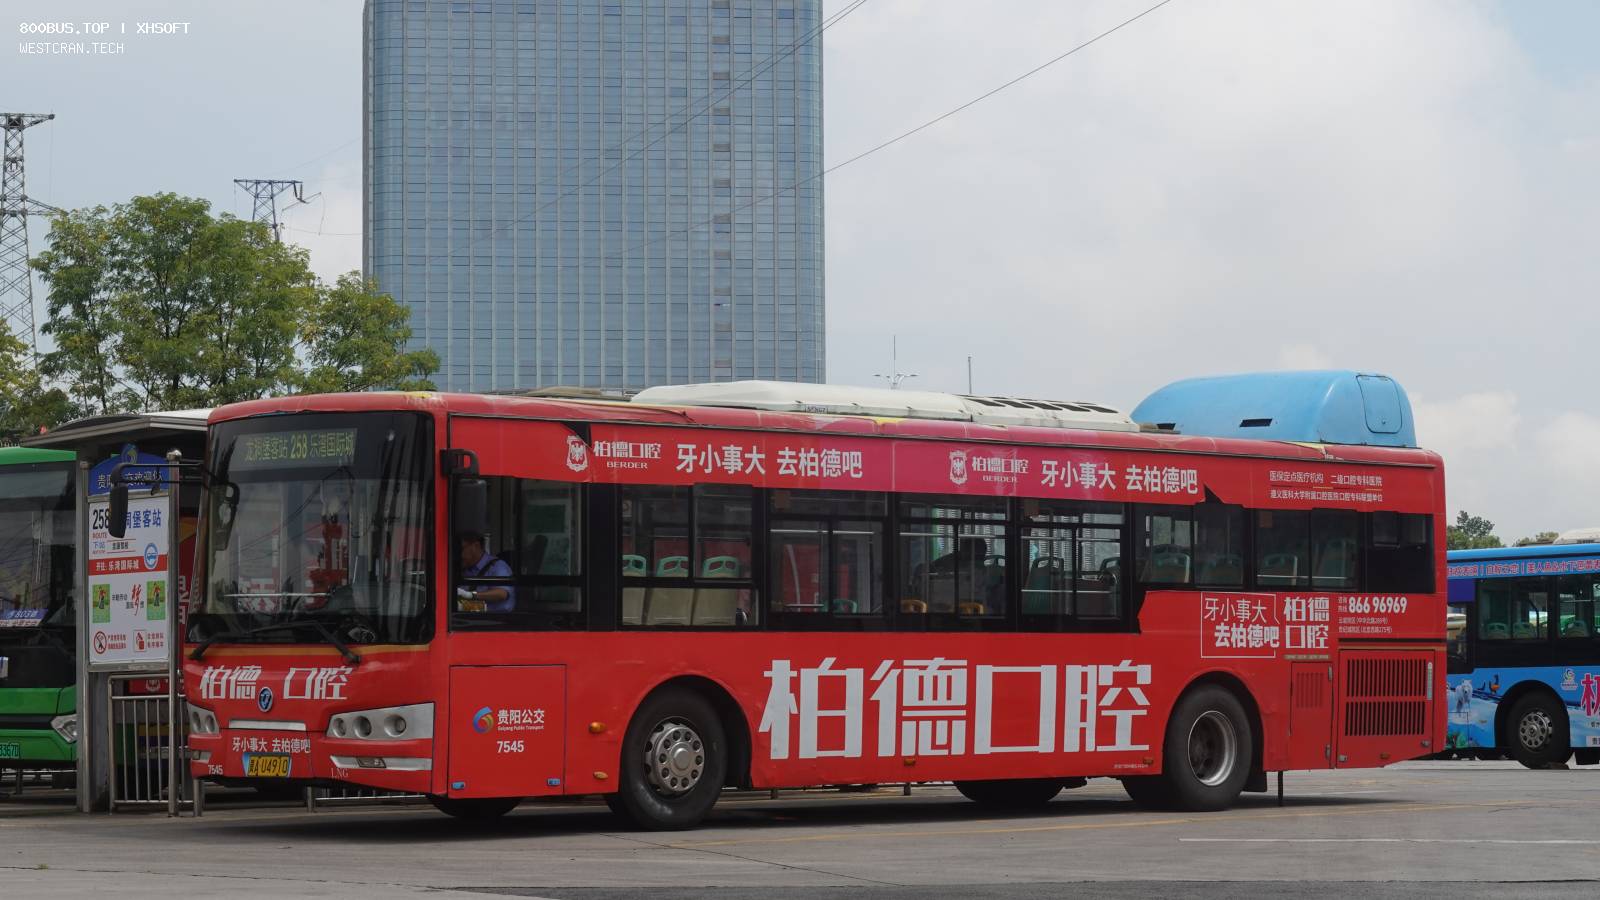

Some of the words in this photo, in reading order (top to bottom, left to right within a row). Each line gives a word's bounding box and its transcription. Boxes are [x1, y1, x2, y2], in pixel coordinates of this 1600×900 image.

[290, 433, 308, 459] 258
[593, 440, 662, 459] 柏德口腔
[606, 461, 648, 469] BERDER
[676, 443, 766, 476] 牙小事大
[777, 446, 863, 479] 去柏德吧
[972, 456, 1029, 474] 柏德口腔
[1041, 460, 1116, 490] 牙小事大
[1125, 464, 1198, 494] 去柏德吧
[1204, 597, 1267, 624] 牙小事大
[1284, 596, 1330, 622] 柏德
[1348, 597, 1370, 614] 866
[1372, 597, 1408, 614] 96969
[1214, 623, 1280, 648] 去柏德吧
[1285, 624, 1329, 649] 口腔
[200, 664, 262, 700] 柏德
[283, 665, 353, 700] 口腔
[497, 708, 545, 725] 贵阳公交
[758, 656, 1152, 760] 柏德口腔
[232, 737, 268, 752] 牙小事大
[271, 738, 311, 753] 去柏德吧
[496, 740, 524, 753] 7545
[207, 764, 223, 776] 7545
[331, 768, 349, 778] LNG
